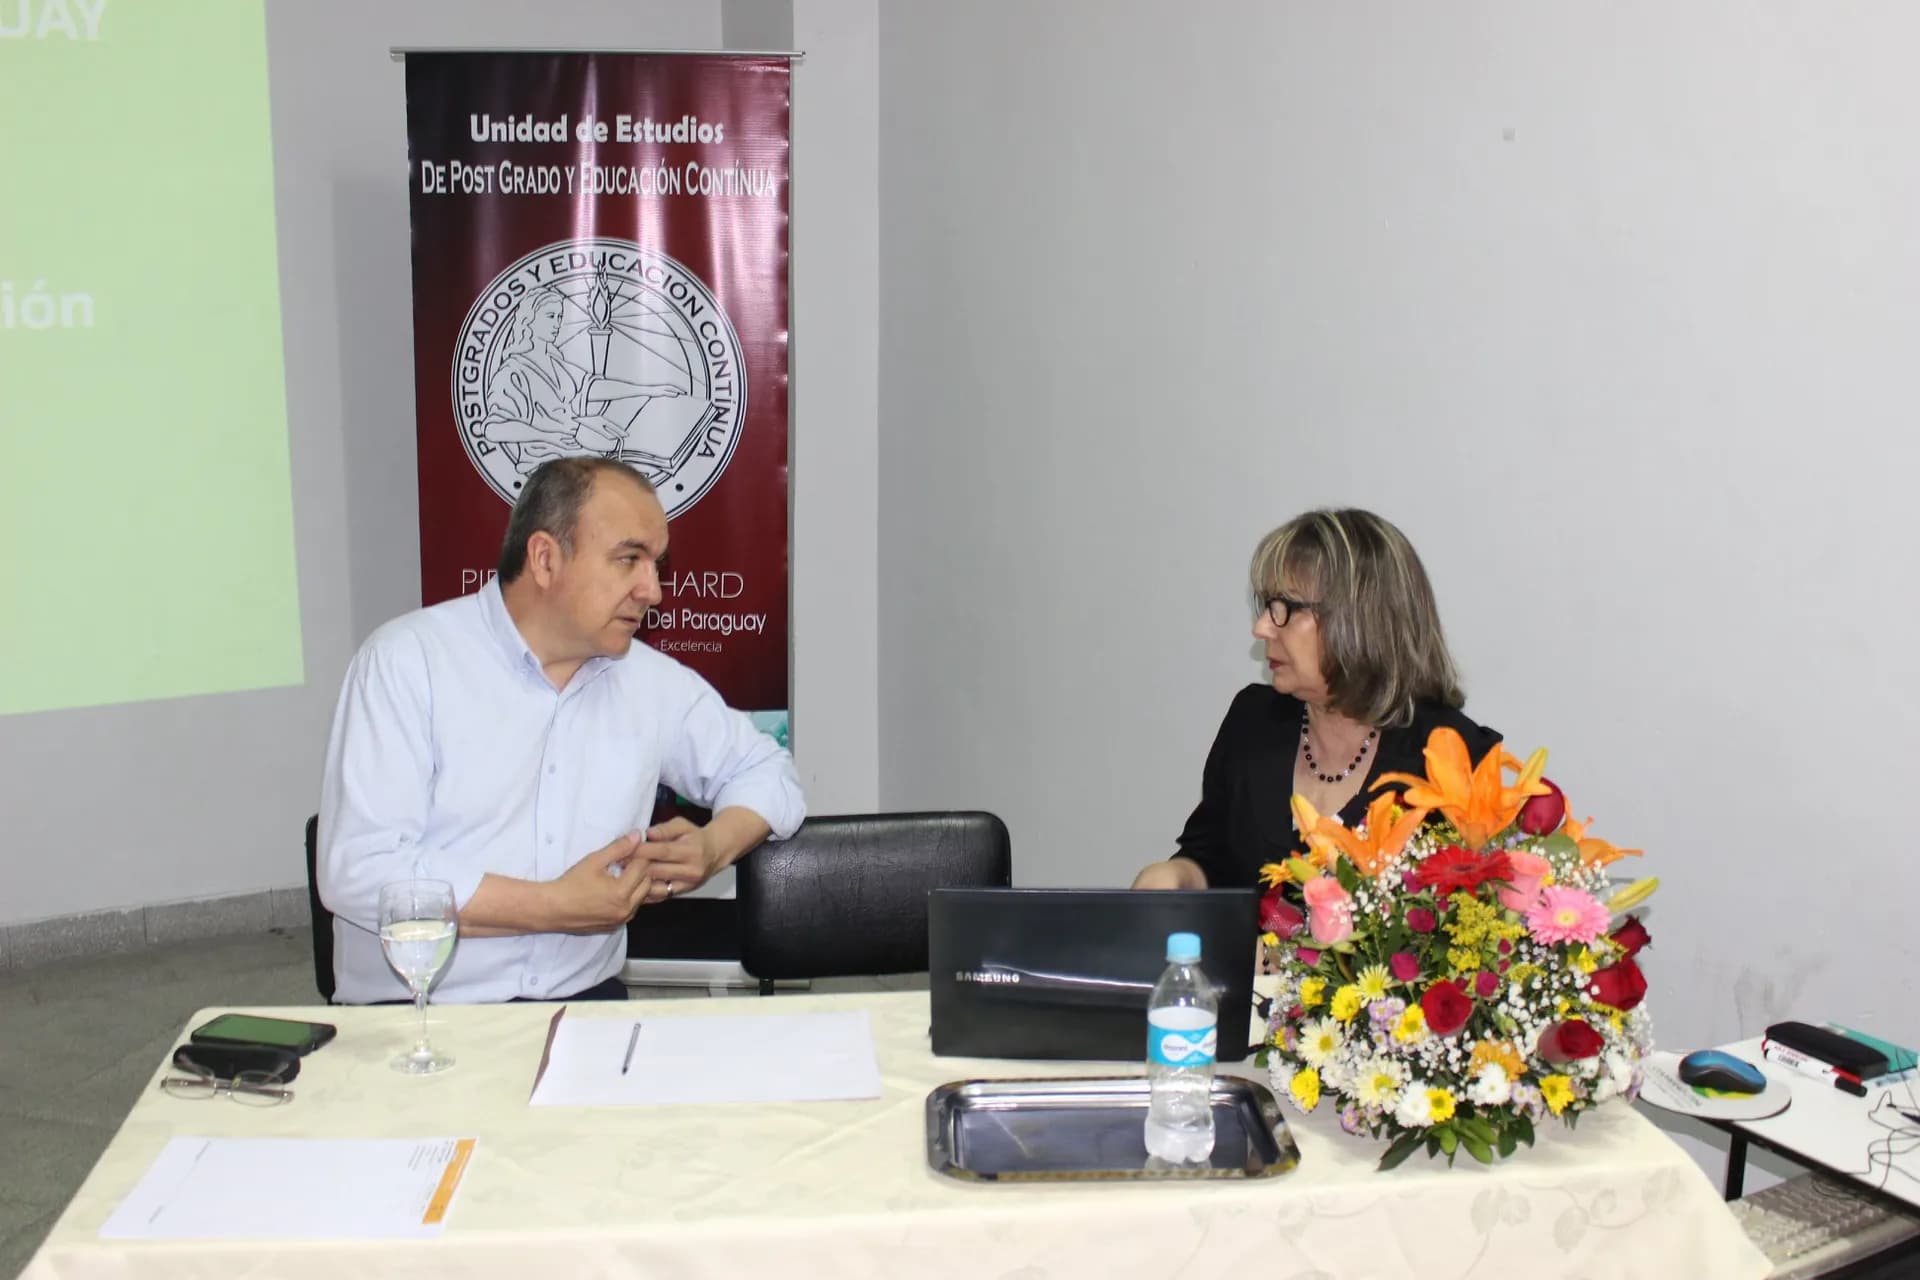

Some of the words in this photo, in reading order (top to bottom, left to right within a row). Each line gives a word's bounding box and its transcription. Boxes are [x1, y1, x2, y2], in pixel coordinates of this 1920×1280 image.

[470, 113, 568, 143] Unidad
[575, 114, 608, 143] de
[615, 114, 724, 144] Estudios
[421, 160, 447, 194] DE
[450, 160, 495, 194] POST
[498, 160, 561, 195] GRADO
[563, 165, 575, 194] Y
[580, 158, 681, 196] EDUCACIÓN
[685, 159, 778, 198] CONTÍNUA
[462, 278, 526, 457] POSTGRADOS
[527, 264, 544, 284] Y
[549, 251, 704, 318] EDUCACIÓN
[697, 321, 733, 460] CONTÍNUA
[647, 608, 676, 631] Del
[682, 608, 767, 636] Paraguay
[660, 640, 722, 653] Excelencia
